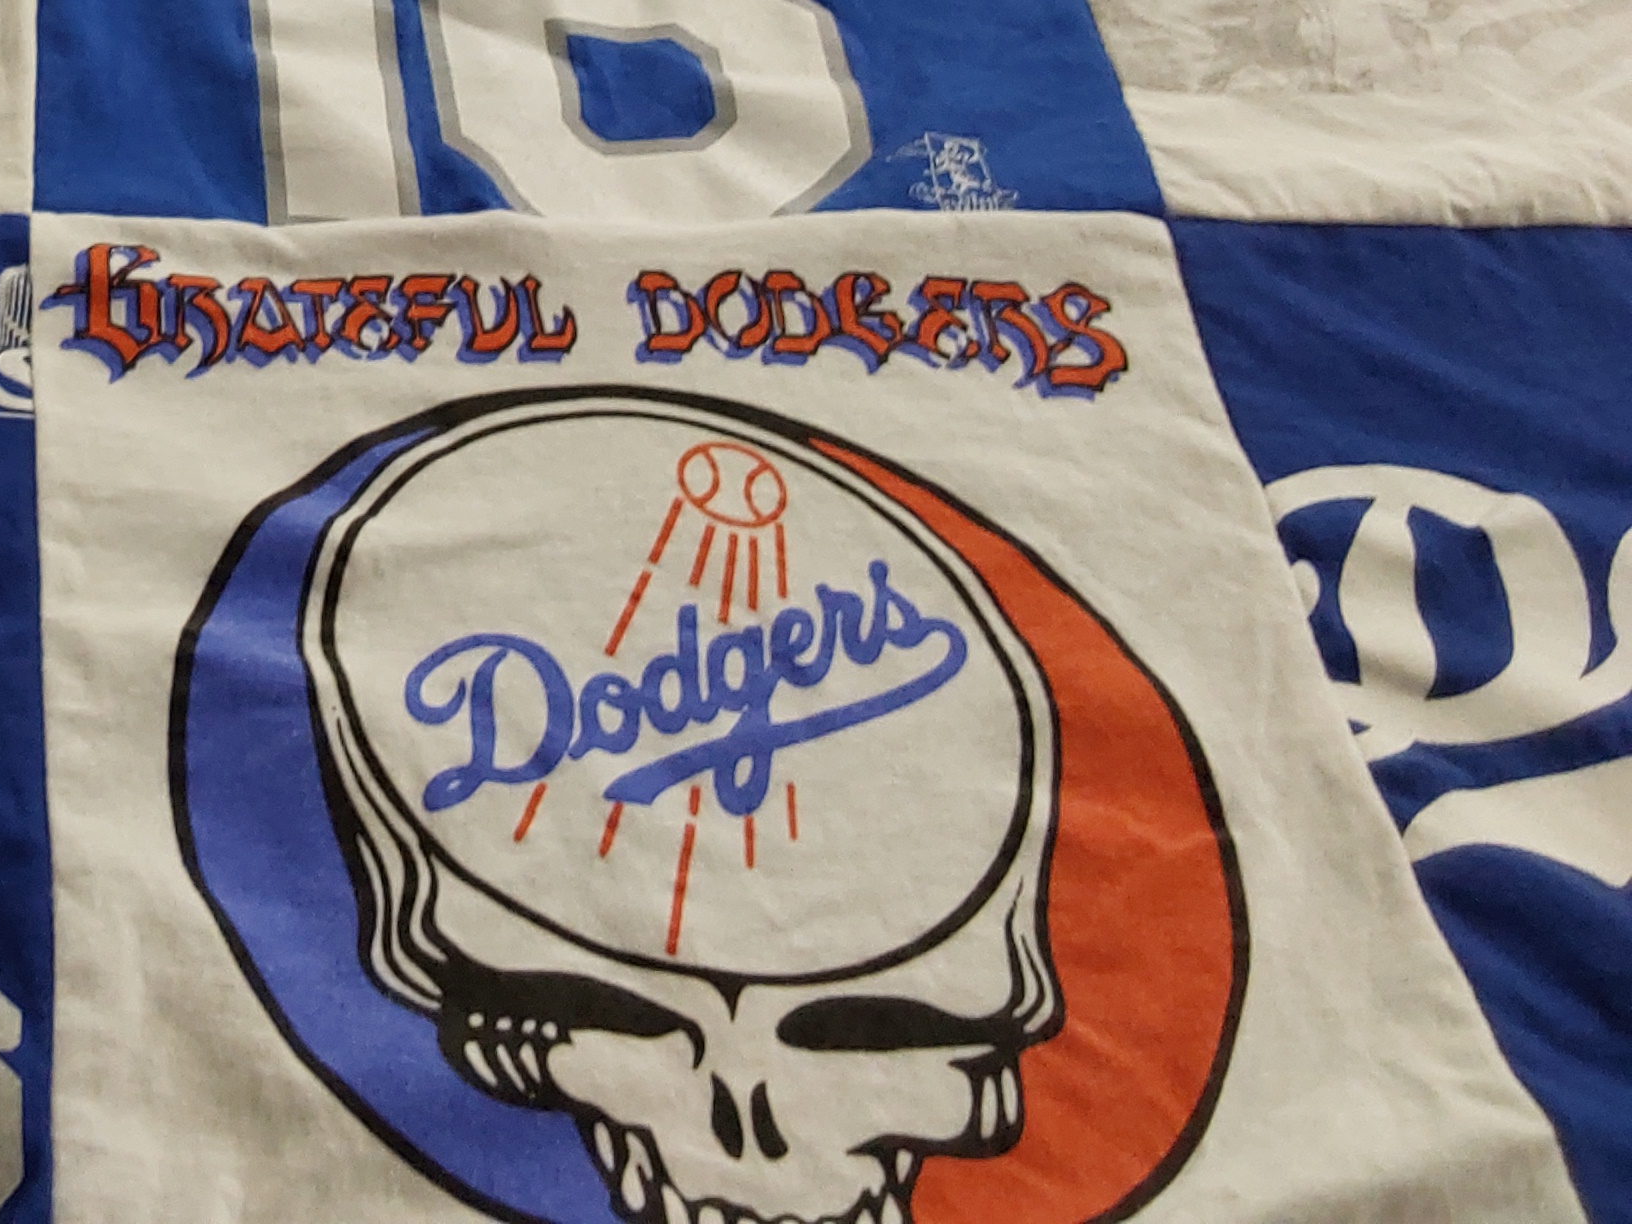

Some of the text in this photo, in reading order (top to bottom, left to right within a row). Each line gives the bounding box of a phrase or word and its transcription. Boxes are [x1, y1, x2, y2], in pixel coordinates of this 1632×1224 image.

[40, 240, 1130, 399] GRATEFUL DODGERS
[402, 560, 970, 818] Dodgers
